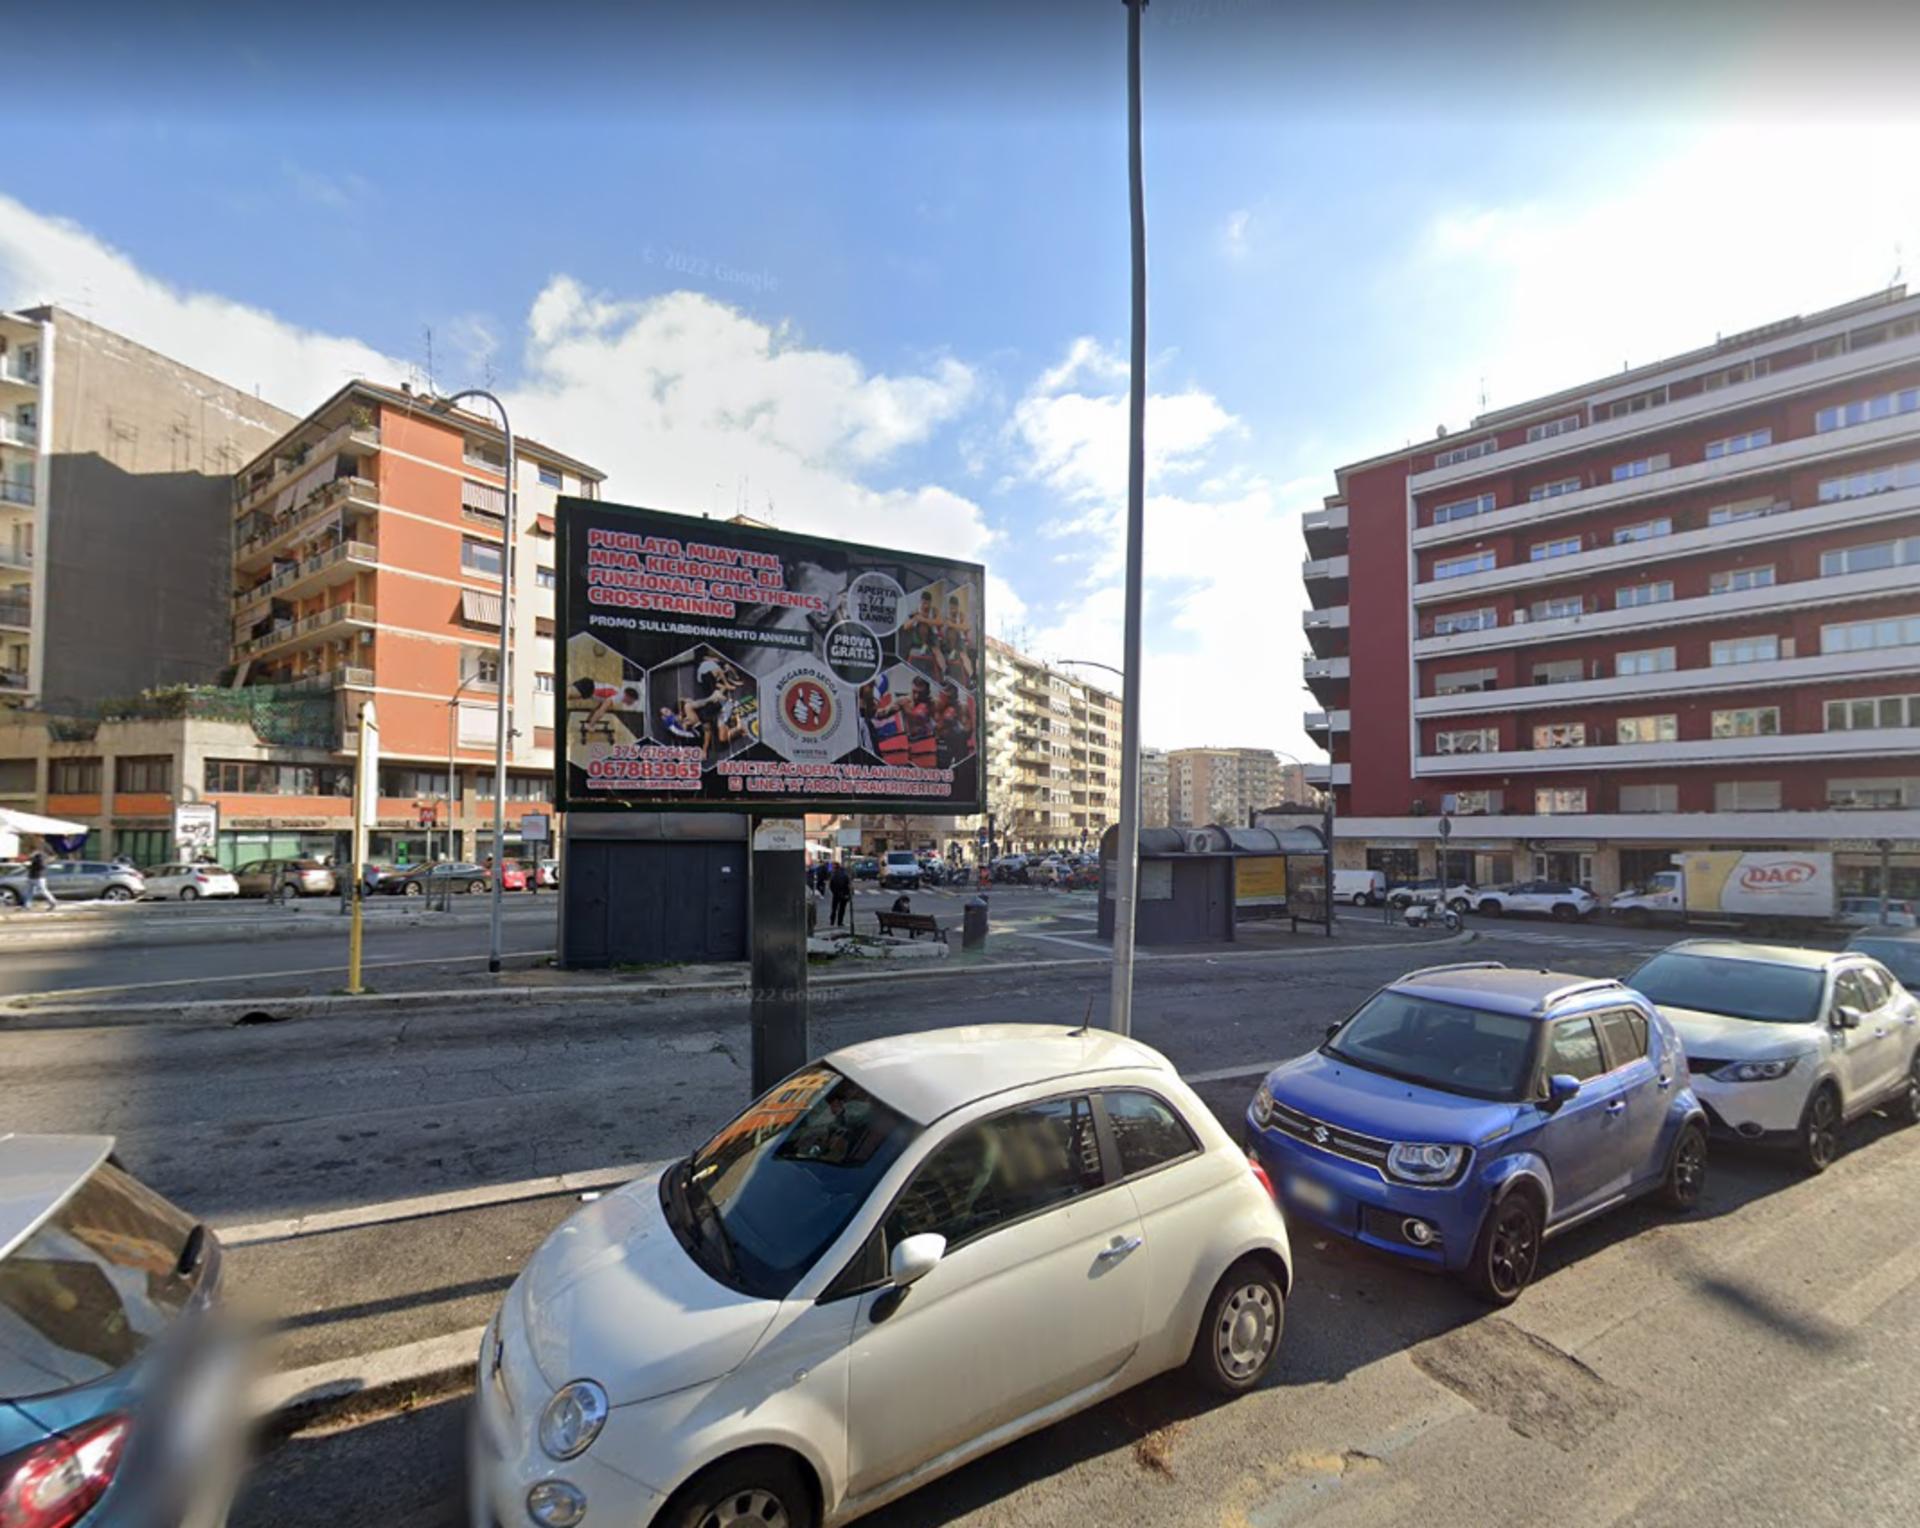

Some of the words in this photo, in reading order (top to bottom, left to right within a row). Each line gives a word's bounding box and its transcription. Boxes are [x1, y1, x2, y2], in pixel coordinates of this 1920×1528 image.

[588, 528, 686, 559] PUGILATO,
[687, 542, 737, 566] MUAY
[588, 547, 645, 574] MMA,
[645, 555, 757, 588] KICKBOXING,
[588, 567, 709, 600] FUNZIONALE,
[710, 582, 828, 615] CALISTHENICS,
[588, 585, 735, 618] CROSSTRAINING
[589, 615, 636, 629] PROMO
[758, 632, 807, 646] ANNUALE
[834, 634, 873, 649] PROVA
[831, 645, 876, 660] GRATIS
[587, 759, 702, 779] 067883965
[1748, 865, 1802, 884] DAC
